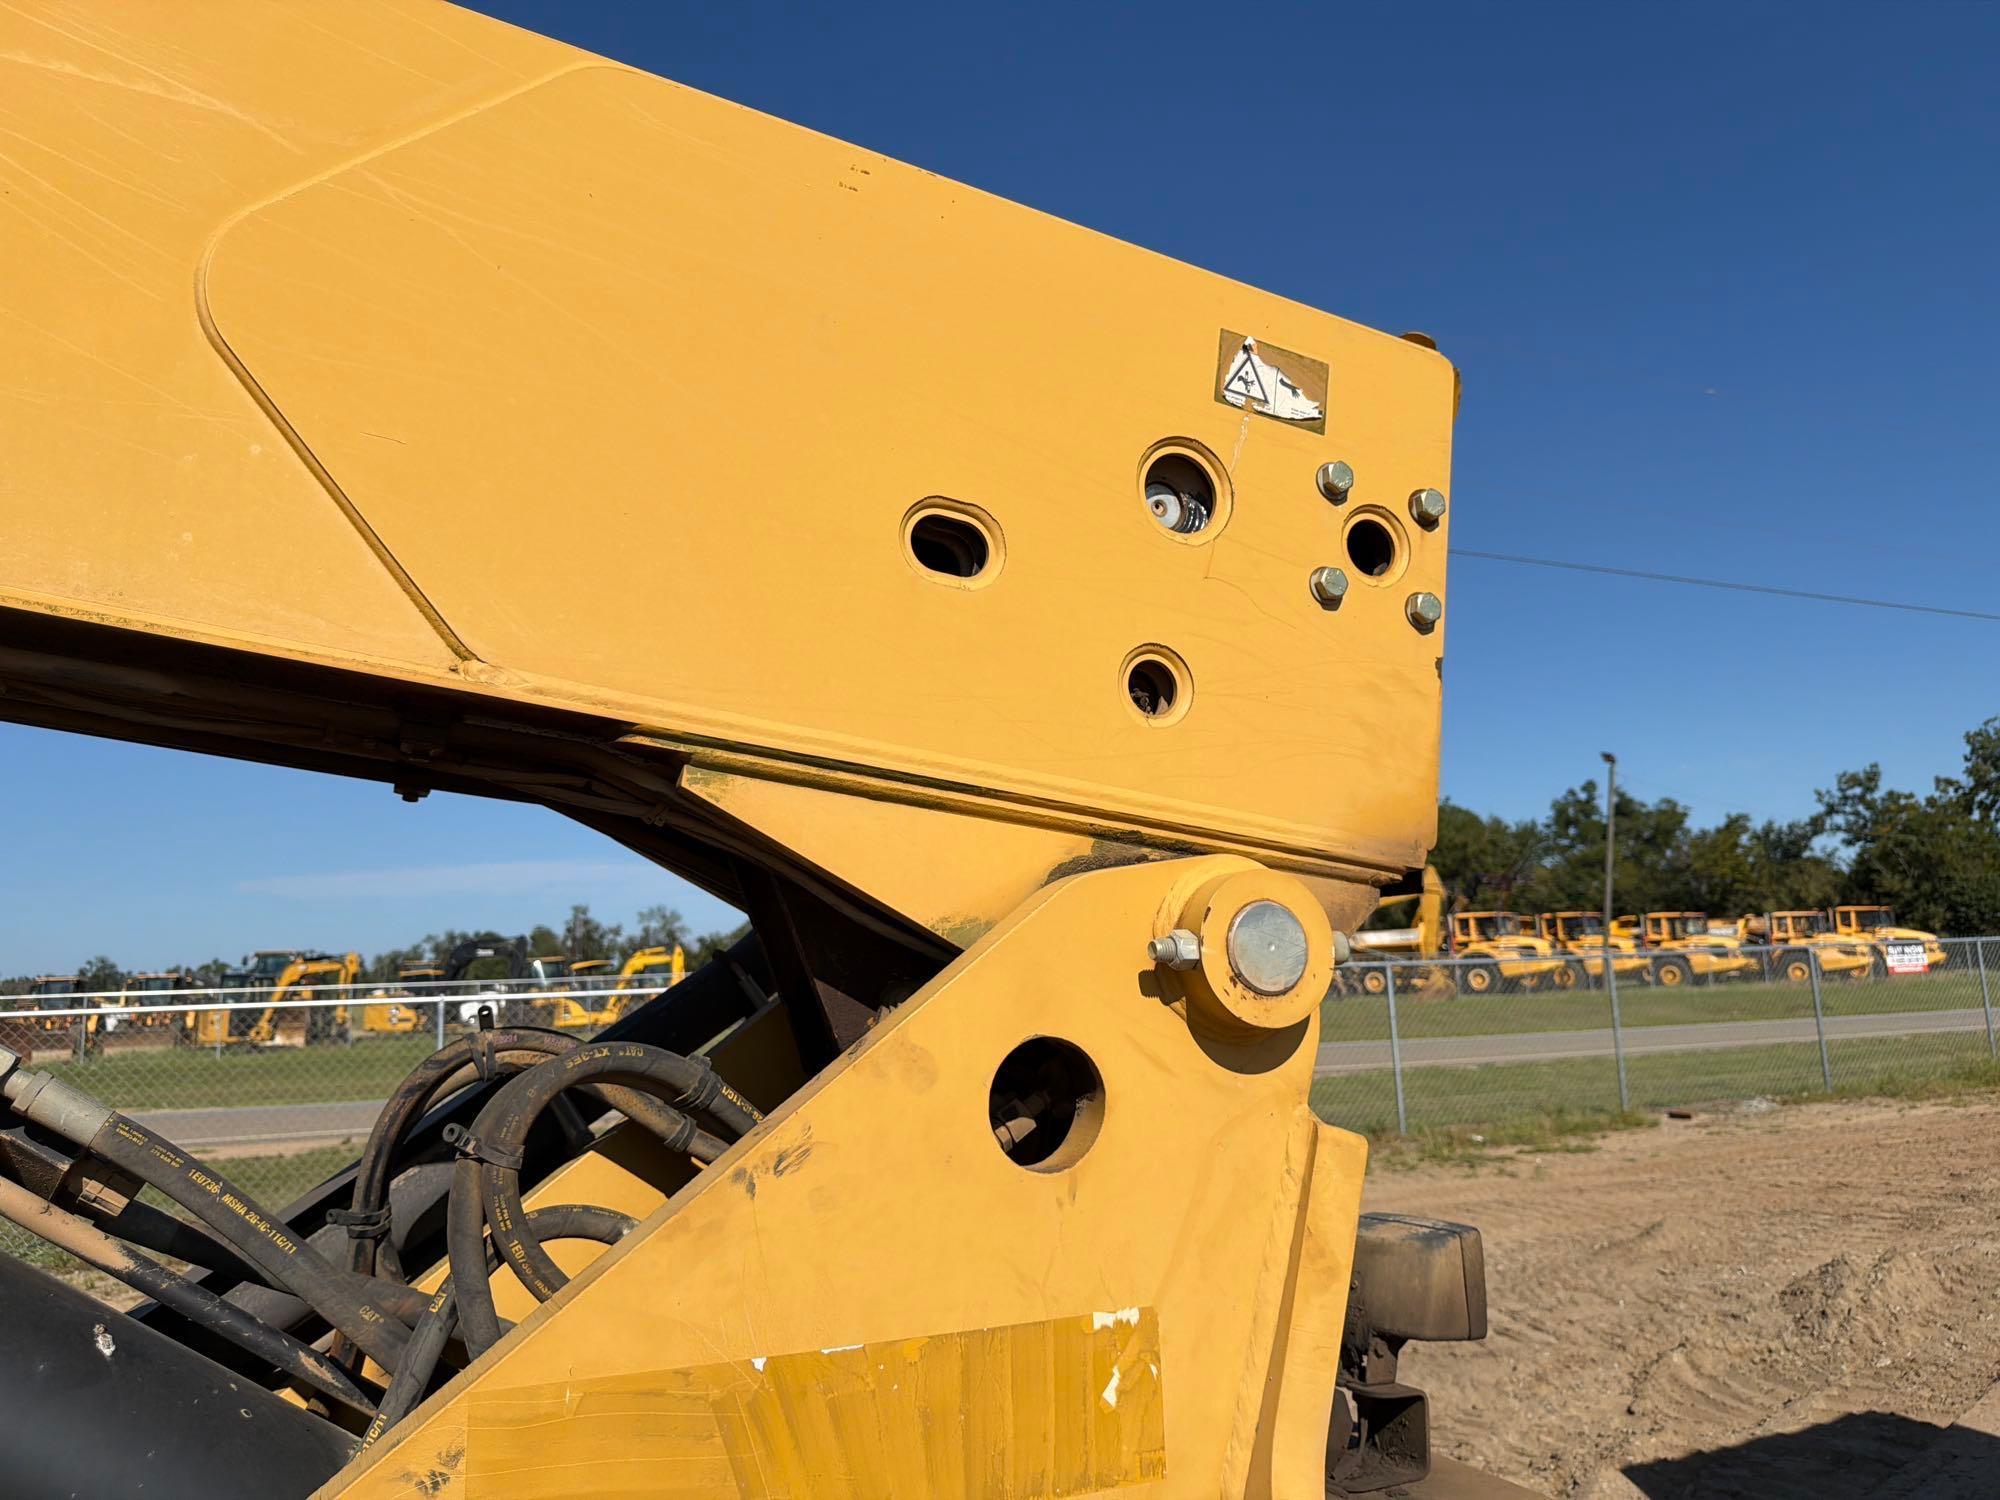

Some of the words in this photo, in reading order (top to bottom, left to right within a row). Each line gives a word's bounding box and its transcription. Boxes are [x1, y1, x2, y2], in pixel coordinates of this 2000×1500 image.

[222, 1193, 247, 1216] MSHA
[245, 1211, 298, 1256] 2G-IC-11C/11
[429, 1292, 448, 1313] CAT
